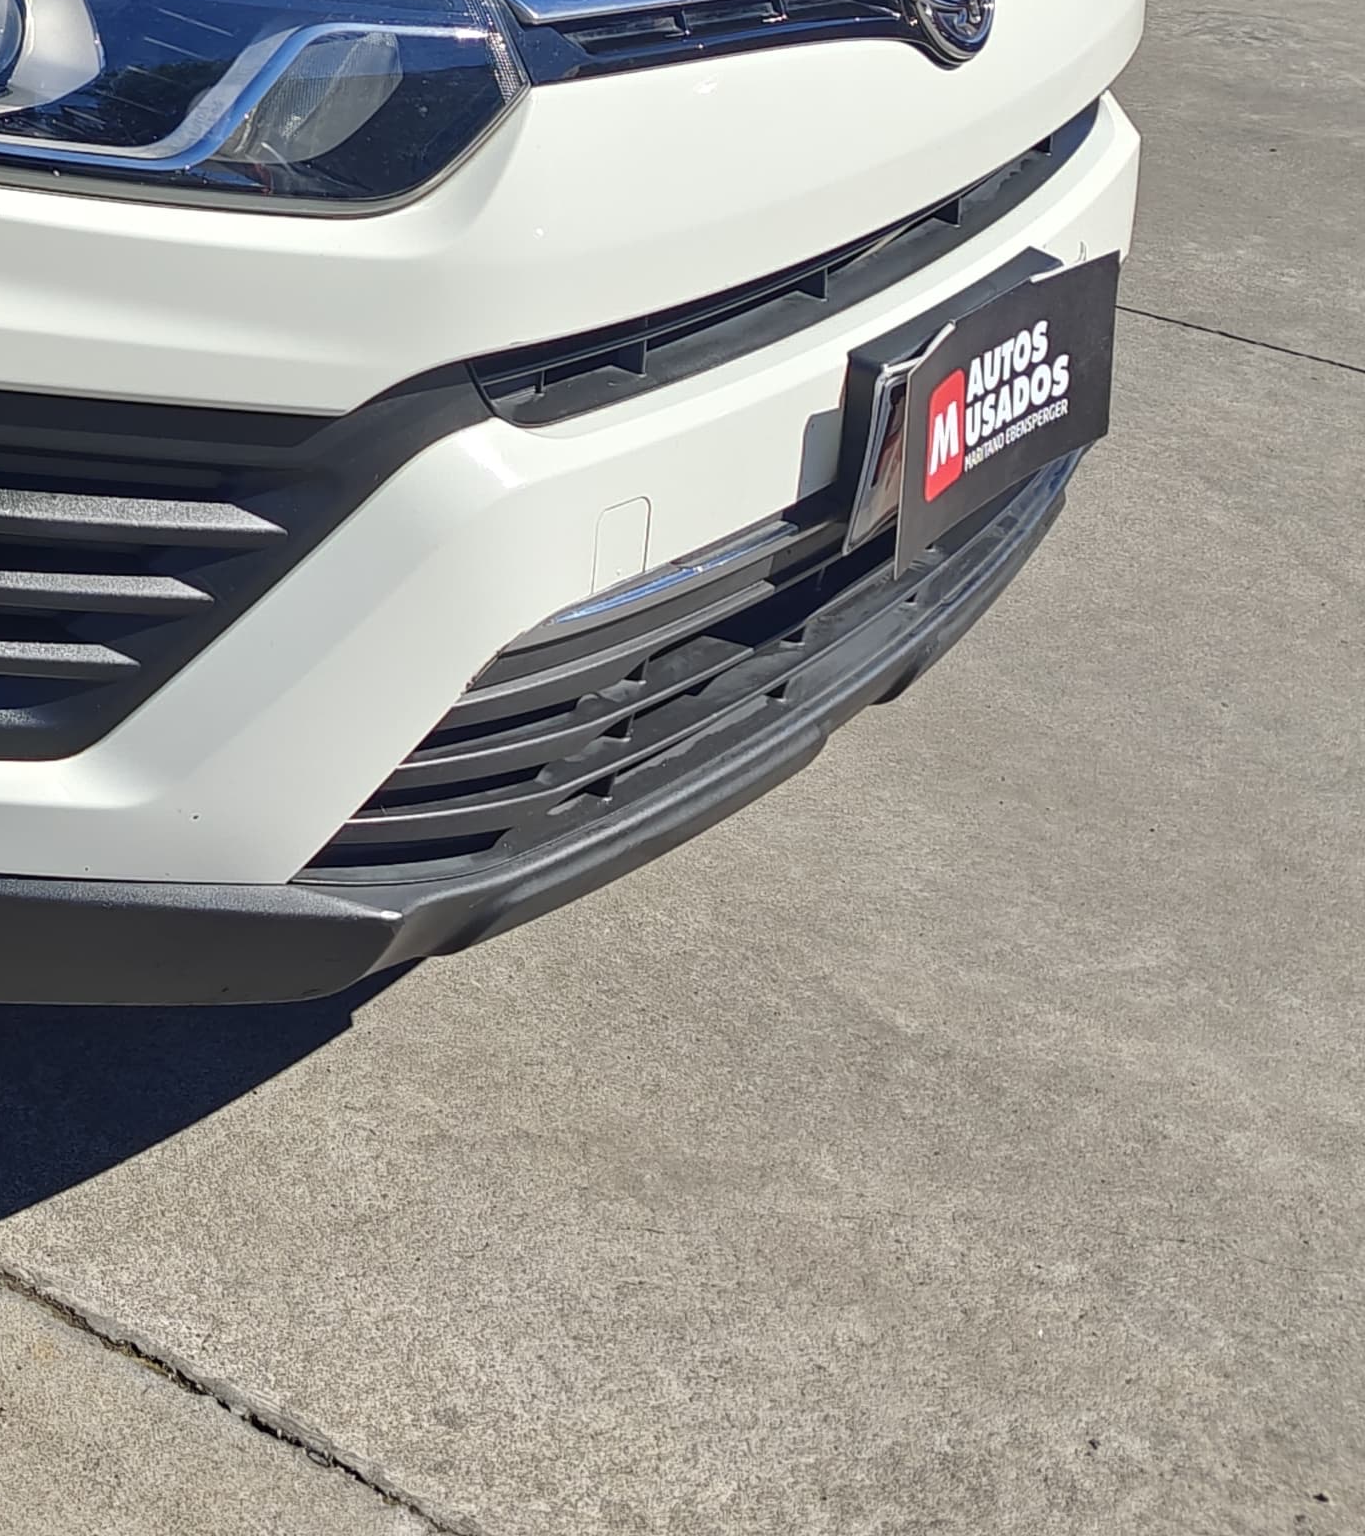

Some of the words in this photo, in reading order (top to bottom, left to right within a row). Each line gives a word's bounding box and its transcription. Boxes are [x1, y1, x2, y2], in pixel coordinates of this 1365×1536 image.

[965, 319, 1049, 404] AUTOS
[965, 355, 1069, 446] USADOS
[929, 401, 959, 475] M
[964, 433, 1004, 471] MARITANO
[1005, 399, 1068, 444] EBENSPERGER
